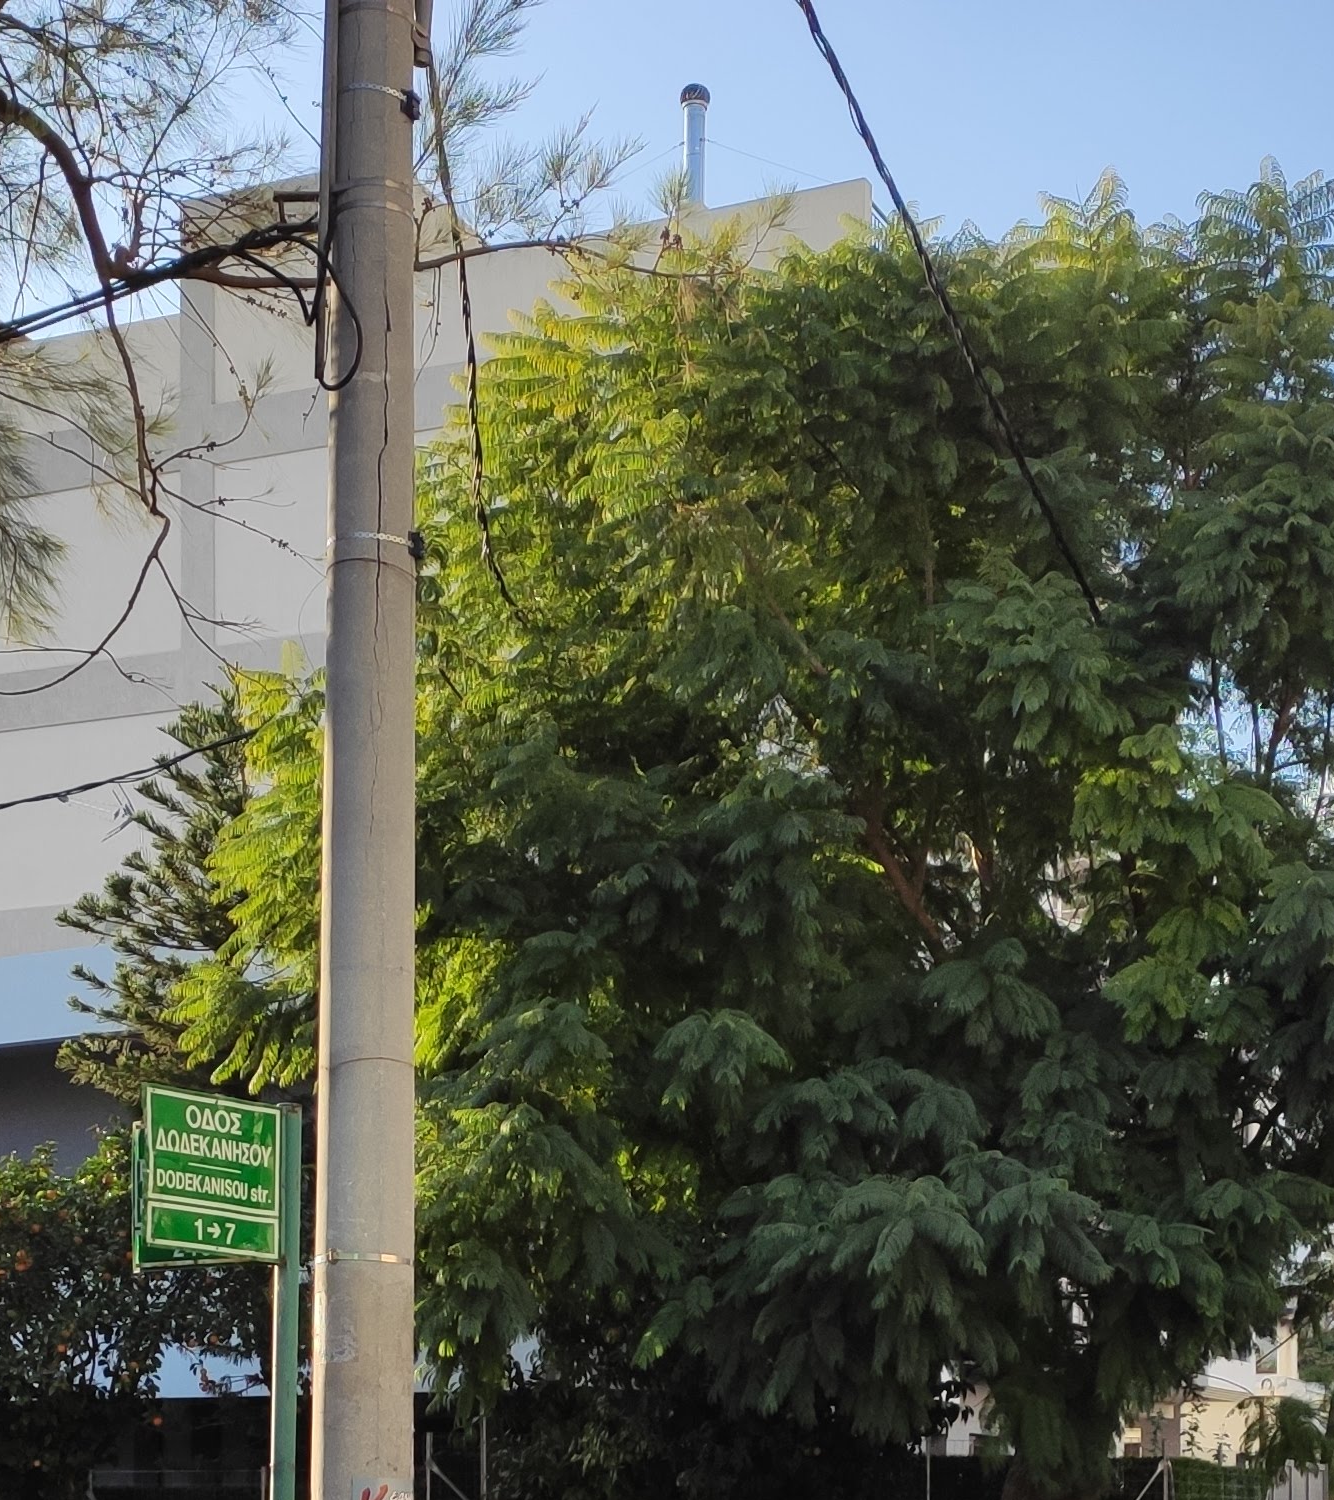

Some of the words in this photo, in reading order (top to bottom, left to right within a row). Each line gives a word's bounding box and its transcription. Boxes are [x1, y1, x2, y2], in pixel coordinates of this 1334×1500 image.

[185, 1104, 243, 1136] ΟΔΟΣ
[155, 1127, 273, 1168] ΔΩΔΕΚΑΝΗΣΟΥ
[156, 1168, 248, 1201] DODEKANISOU
[250, 1184, 272, 1204] str.
